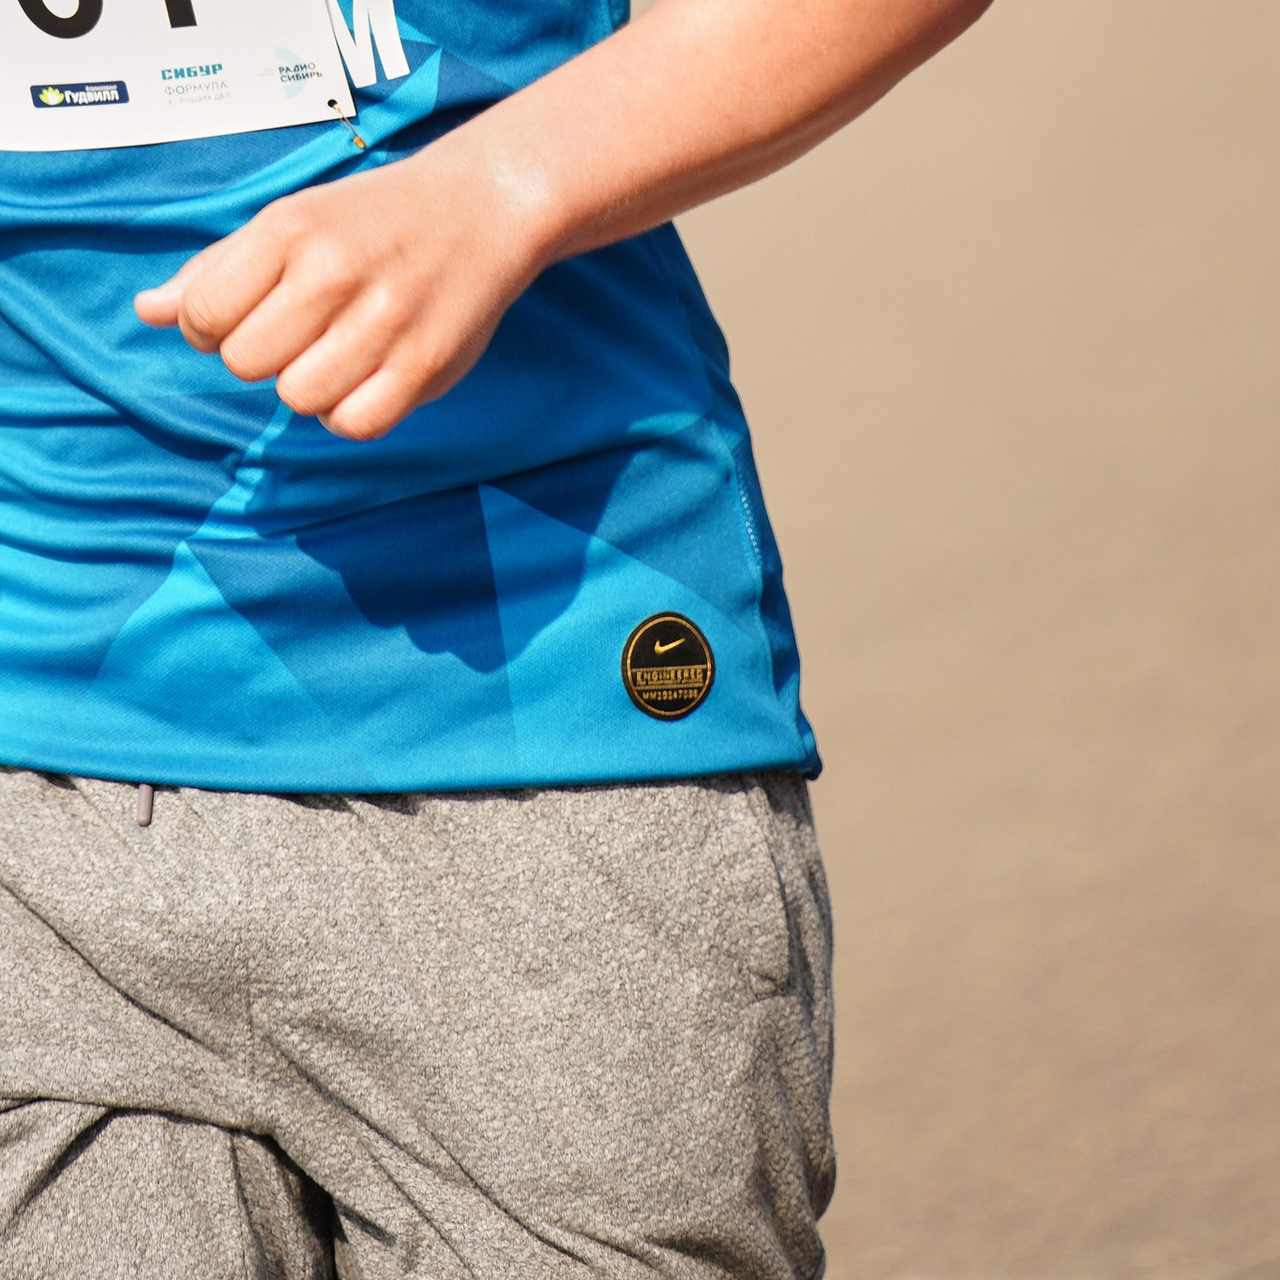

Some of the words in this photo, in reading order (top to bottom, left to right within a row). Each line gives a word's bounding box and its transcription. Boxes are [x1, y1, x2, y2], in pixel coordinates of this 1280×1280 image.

[161, 63, 222, 80] СИБУР
[278, 62, 316, 74] РАДИО
[280, 71, 323, 83] СИБИРЬ
[165, 81, 228, 95] ФОРМУЛА
